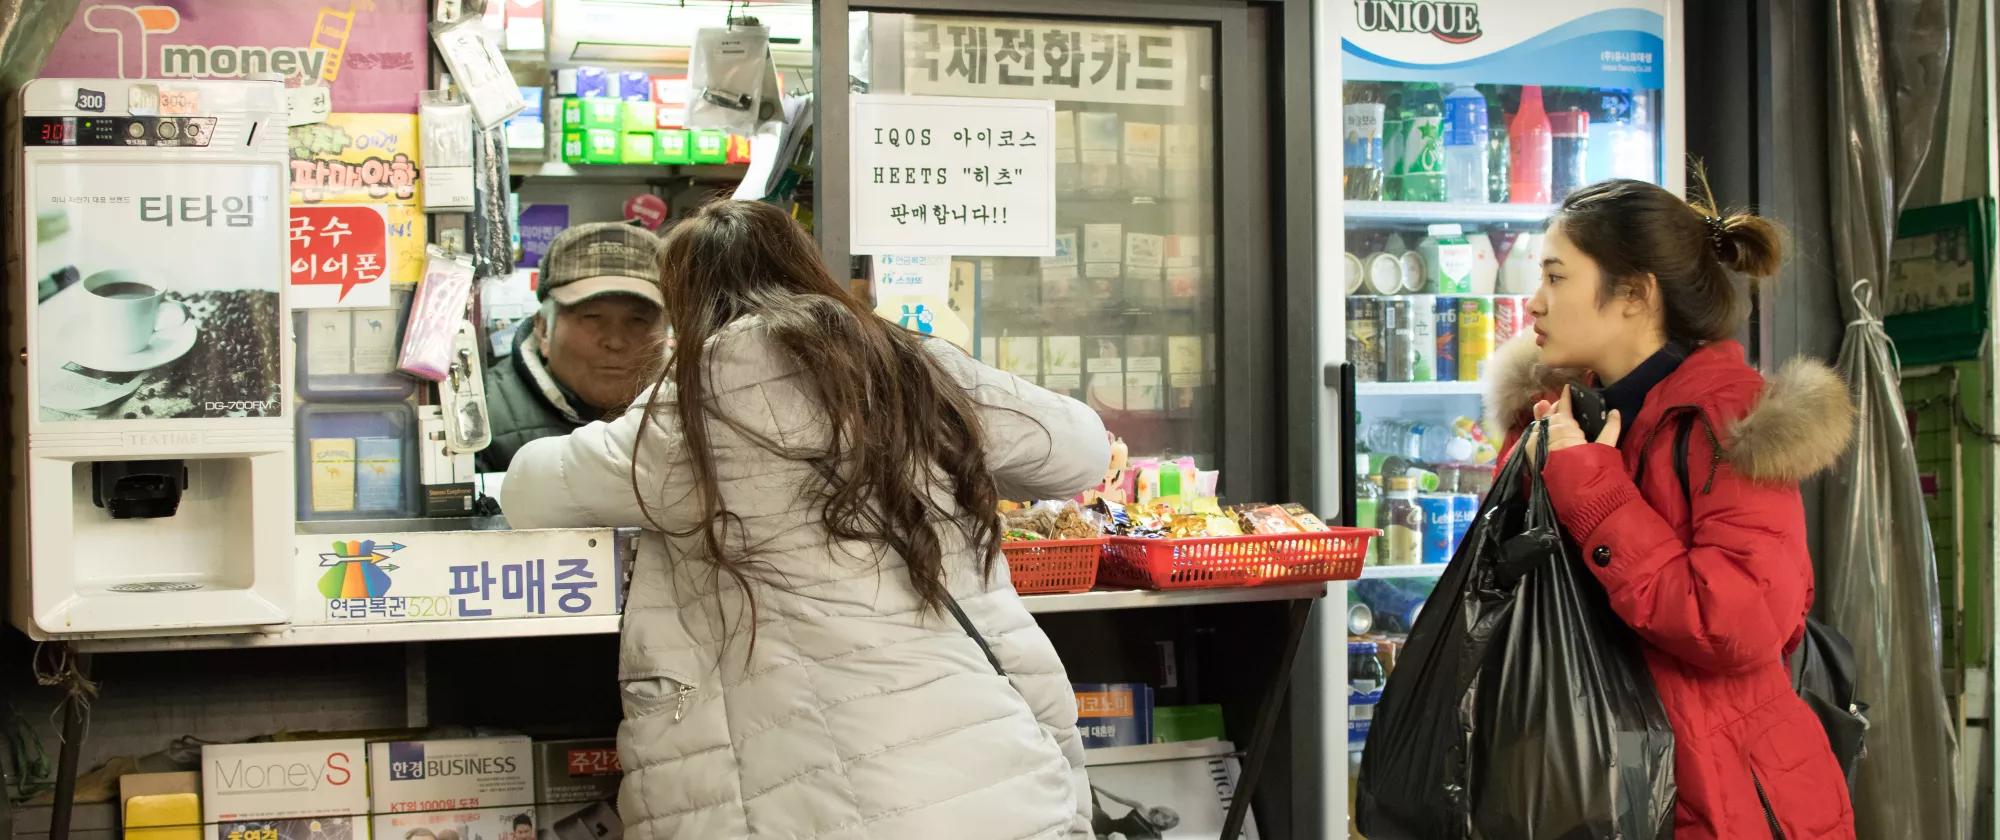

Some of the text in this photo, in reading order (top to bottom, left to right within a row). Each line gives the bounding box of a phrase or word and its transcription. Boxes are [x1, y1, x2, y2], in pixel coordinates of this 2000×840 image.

[1356, 0, 1482, 42] UNIQUE
[161, 45, 330, 87] money
[907, 22, 1173, 91] 국제전화카드
[874, 127, 1037, 149] IQOS 아이코스
[873, 165, 1023, 186] HEETS "히츠"
[140, 195, 254, 227] 티타임
[890, 204, 1008, 225] 판매합니다!!
[291, 253, 380, 280] 이어폰
[449, 558, 598, 617] 판매중
[215, 752, 351, 792] MoneyS
[392, 756, 516, 779] 한경 BUSINESS
